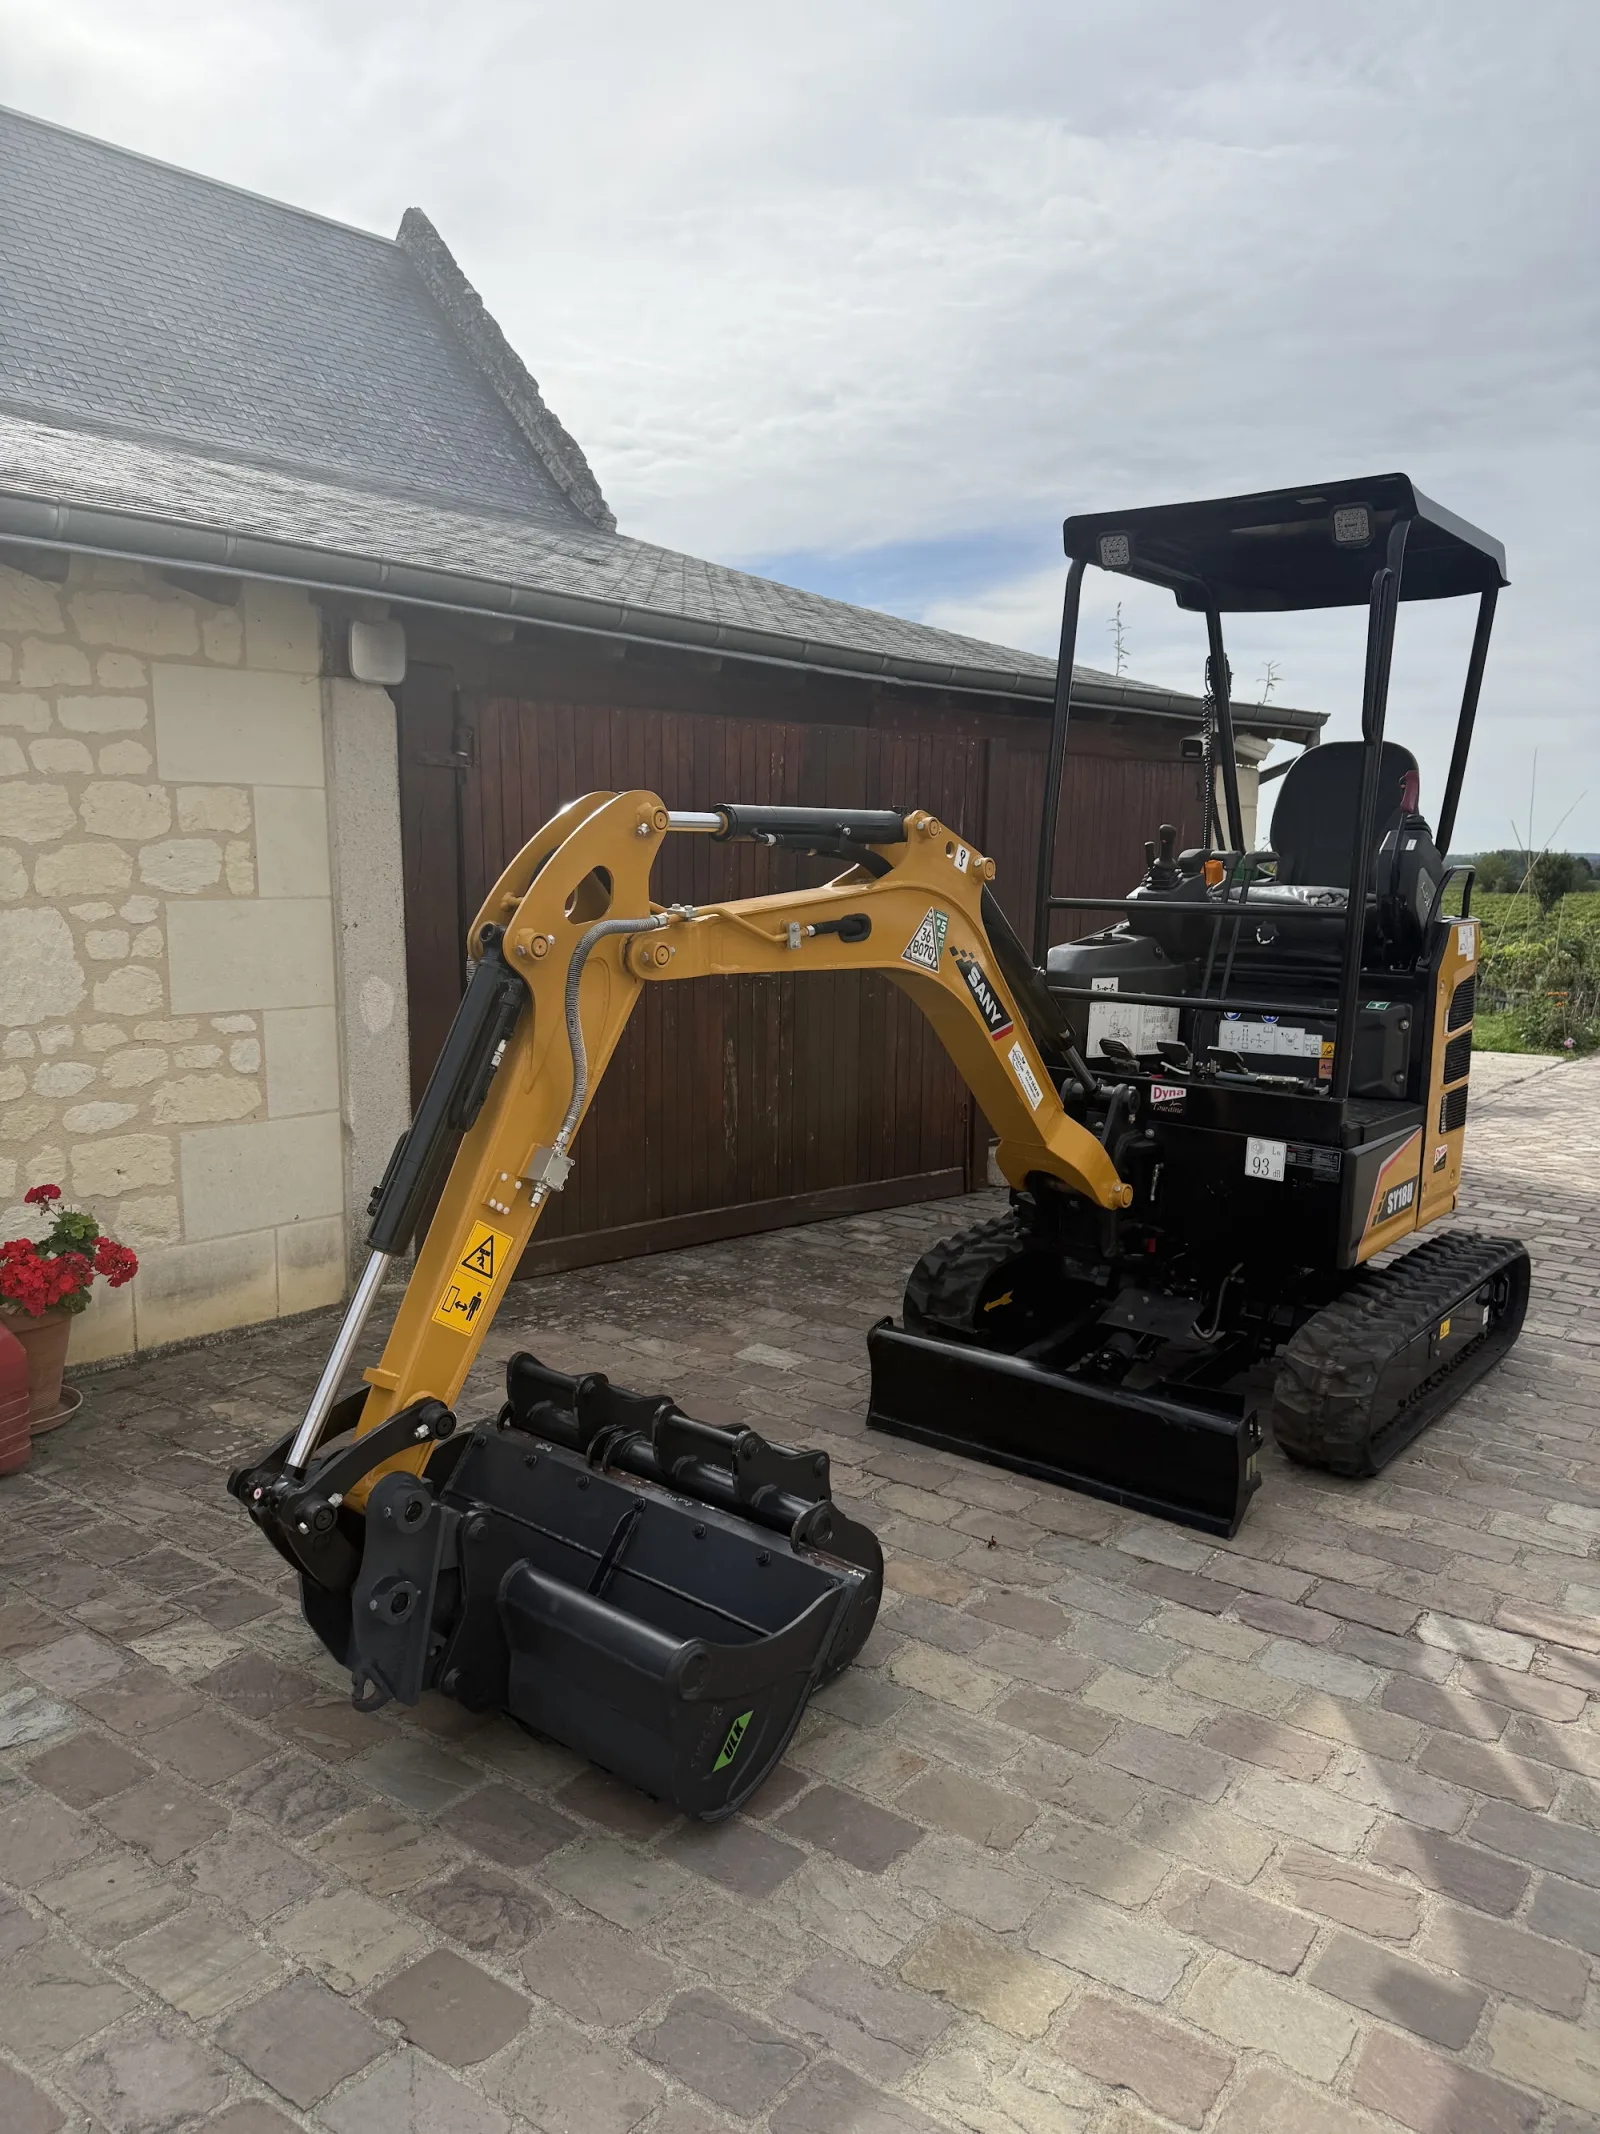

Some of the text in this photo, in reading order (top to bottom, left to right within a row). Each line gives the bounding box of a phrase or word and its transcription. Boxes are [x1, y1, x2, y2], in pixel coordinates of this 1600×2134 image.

[920, 927, 932, 944] 36
[967, 966, 1002, 1025] SANY
[1153, 1086, 1184, 1101] Dyna
[1252, 1156, 1270, 1176] 93
[1387, 1181, 1414, 1215] SY18U
[723, 1719, 745, 1760] ULK
